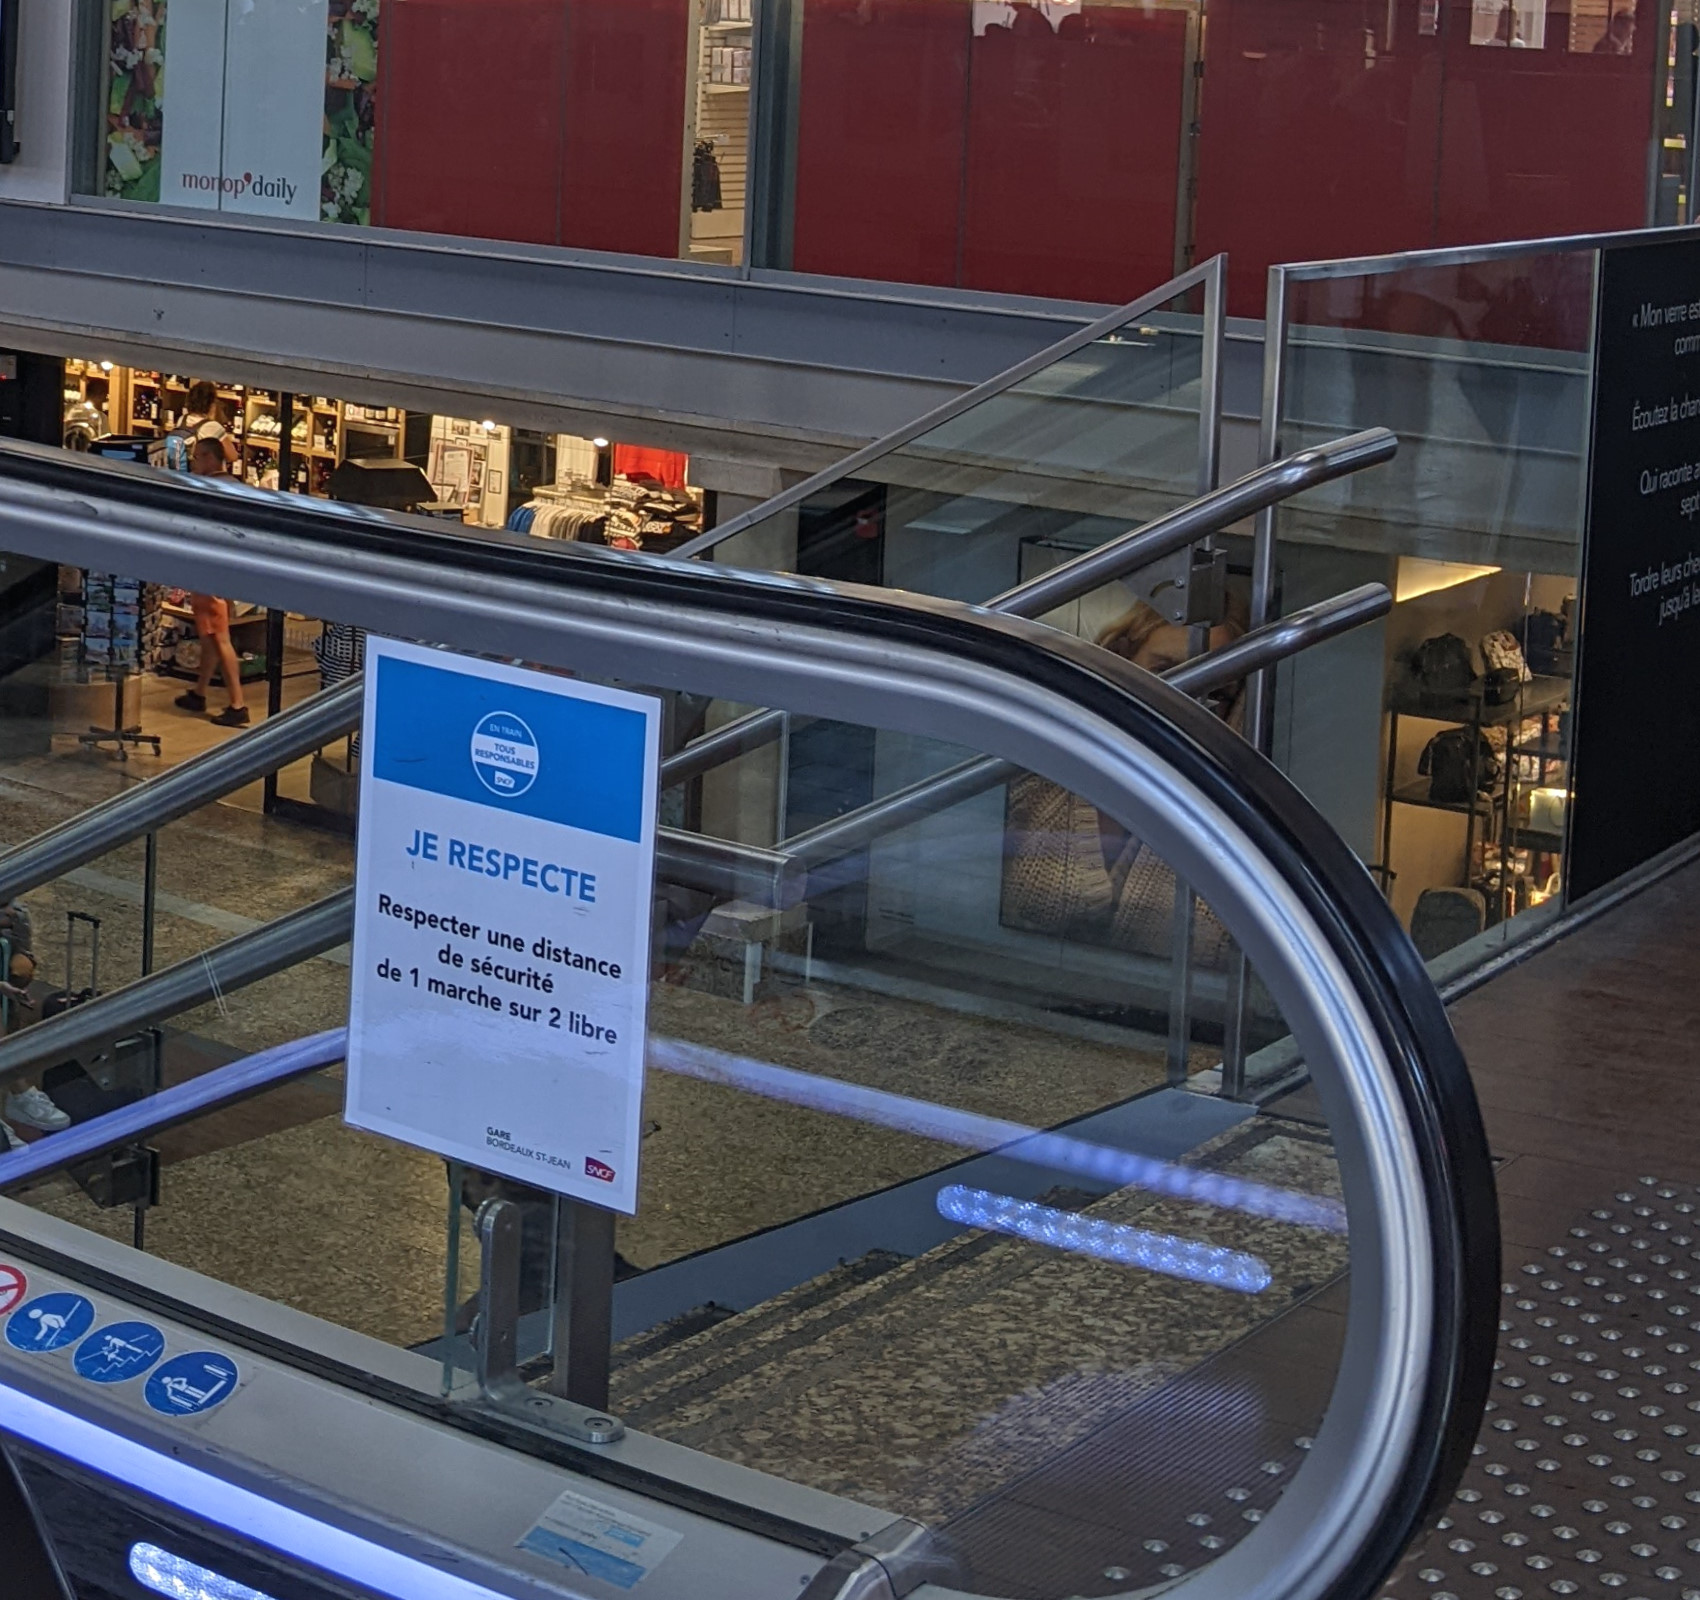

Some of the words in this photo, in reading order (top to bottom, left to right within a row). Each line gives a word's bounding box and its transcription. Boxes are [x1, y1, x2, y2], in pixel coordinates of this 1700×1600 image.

[1640, 303, 1663, 327] Mon
[1664, 304, 1688, 323] verre
[1632, 400, 1669, 430] Écoutez
[1670, 396, 1678, 421] la
[1640, 467, 1658, 494] Qui
[1659, 463, 1693, 488] raconte
[1629, 567, 1659, 596] Tordre
[1660, 561, 1682, 585] leurs
[489, 722, 500, 732] EN
[501, 724, 523, 739] TRAIN
[474, 748, 535, 771] RESPONSABLES
[493, 742, 516, 755] TOUS
[495, 774, 515, 787] SNCF
[405, 829, 439, 861] JE
[449, 838, 597, 903] RESPECTE
[378, 893, 481, 940] Respecter
[487, 929, 525, 953] une
[532, 936, 622, 979] distance
[438, 943, 464, 968] de
[470, 955, 554, 994] sécurité
[376, 958, 402, 983] de
[409, 967, 420, 988] 1
[427, 976, 502, 1011] marche
[508, 1001, 542, 1022] sur
[548, 1007, 561, 1029] 2
[568, 1011, 617, 1045] libre
[486, 1126, 511, 1141] GARE
[486, 1136, 534, 1159] BORDEAUX
[535, 1150, 571, 1170] ST-JEAN
[586, 1163, 614, 1180] SNCF
